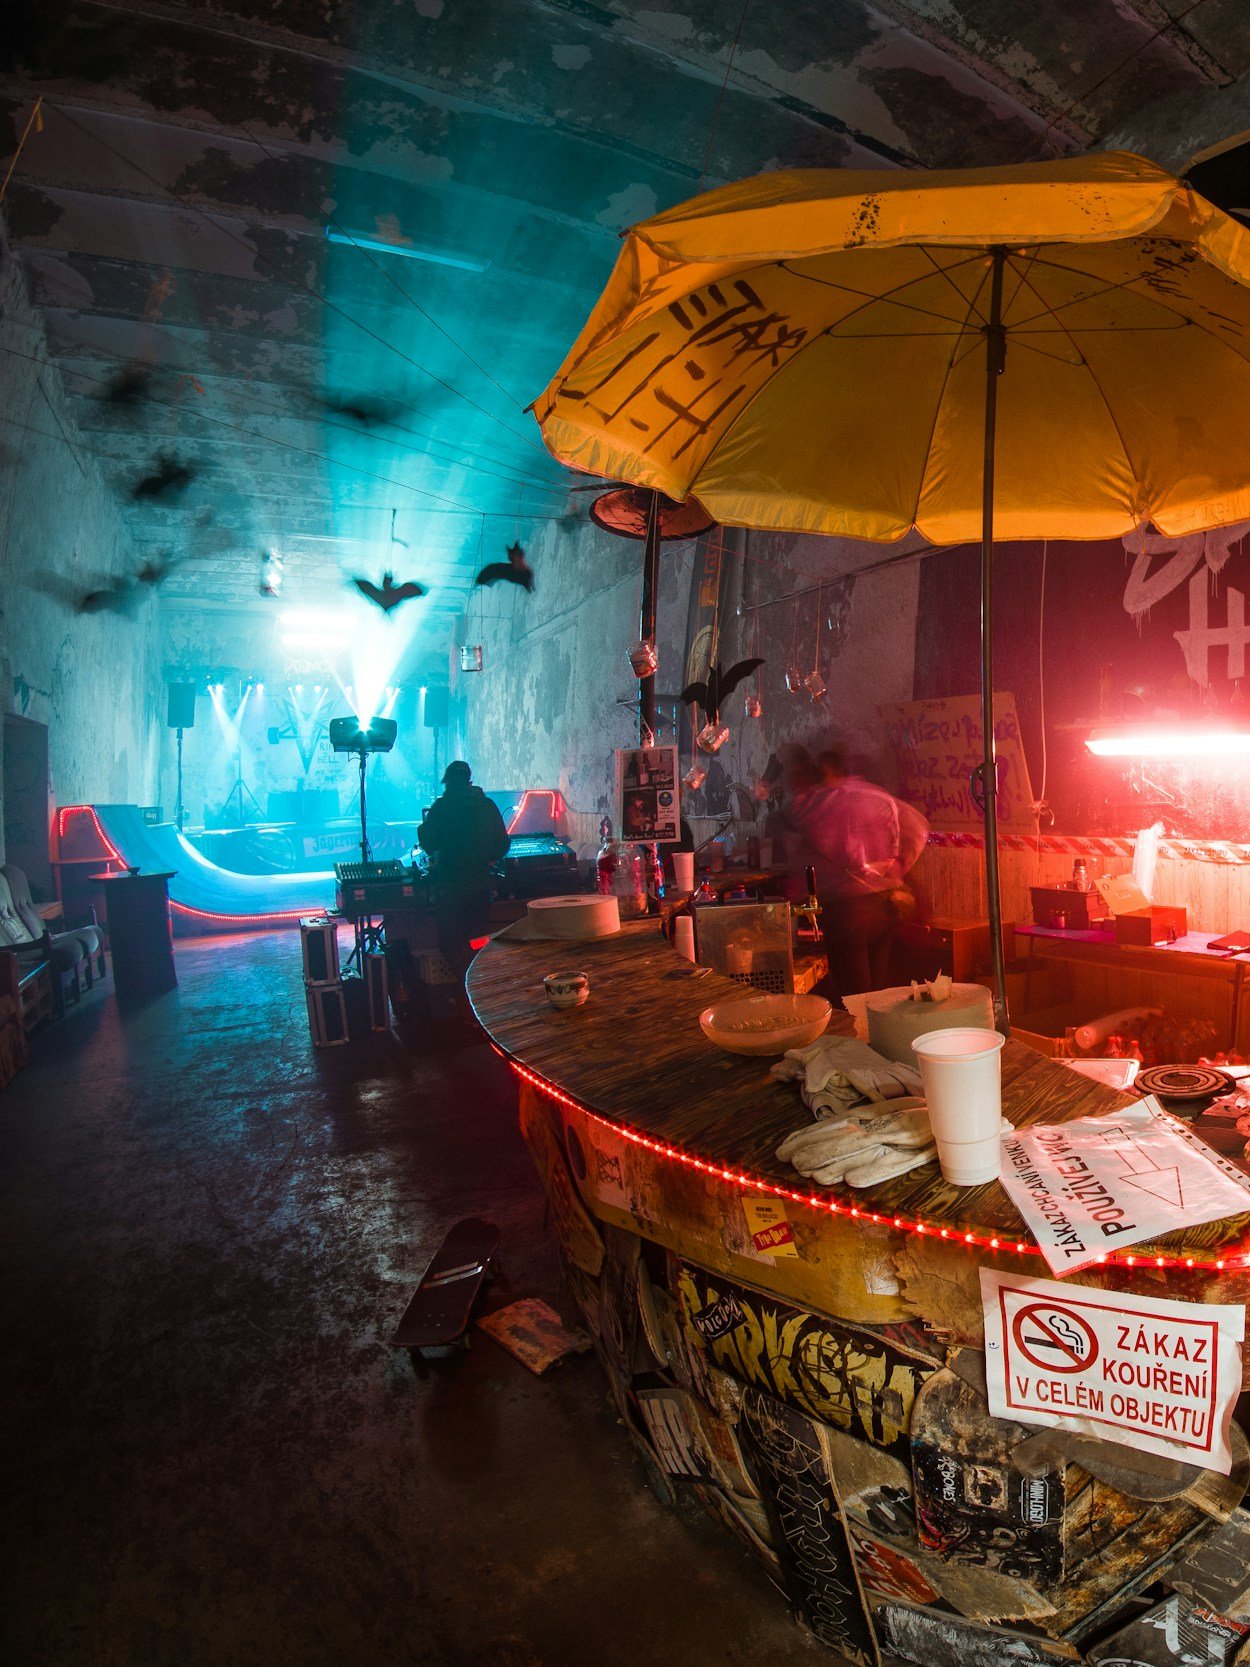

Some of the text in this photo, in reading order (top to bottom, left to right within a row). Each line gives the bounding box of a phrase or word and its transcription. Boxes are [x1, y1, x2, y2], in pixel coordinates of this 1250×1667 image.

[1015, 1170, 1059, 1212] CHCANÍ
[1052, 1155, 1137, 1237] POUŽÍVEJ
[1044, 1211, 1087, 1258] ZÁKAZ
[1116, 1319, 1208, 1365] ZÁKAZ
[1102, 1356, 1208, 1400] KOUŘENÍ
[1016, 1376, 1206, 1438] V CELÉM OBJEKTU
